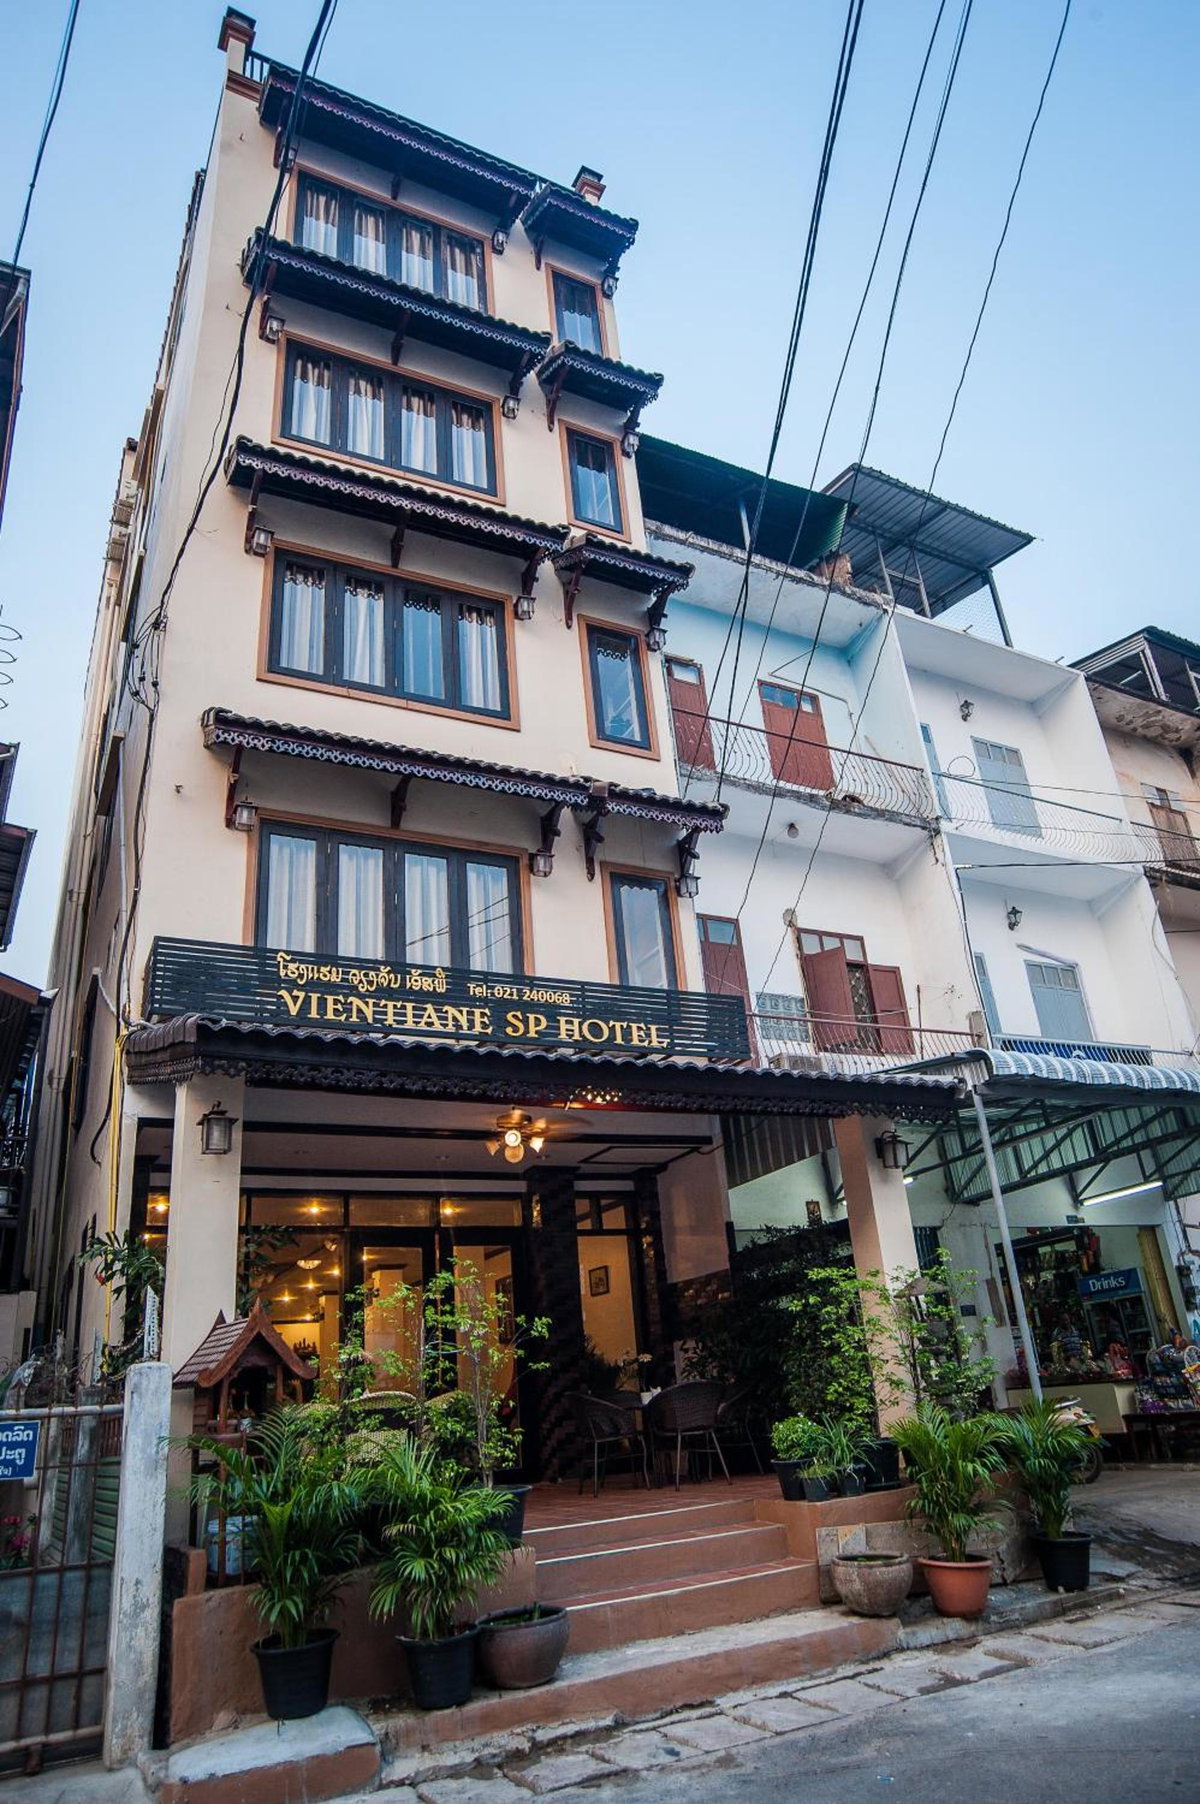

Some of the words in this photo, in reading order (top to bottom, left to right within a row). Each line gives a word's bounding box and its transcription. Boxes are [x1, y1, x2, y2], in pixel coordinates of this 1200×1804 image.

[466, 983, 491, 998] Tel:
[494, 986, 519, 1001] 021
[522, 989, 571, 1005] 240068
[276, 988, 494, 1036] VIENTIANE
[504, 1010, 549, 1039] SP
[556, 1015, 671, 1048] HOTEL
[1088, 1275, 1126, 1292] Drinks
